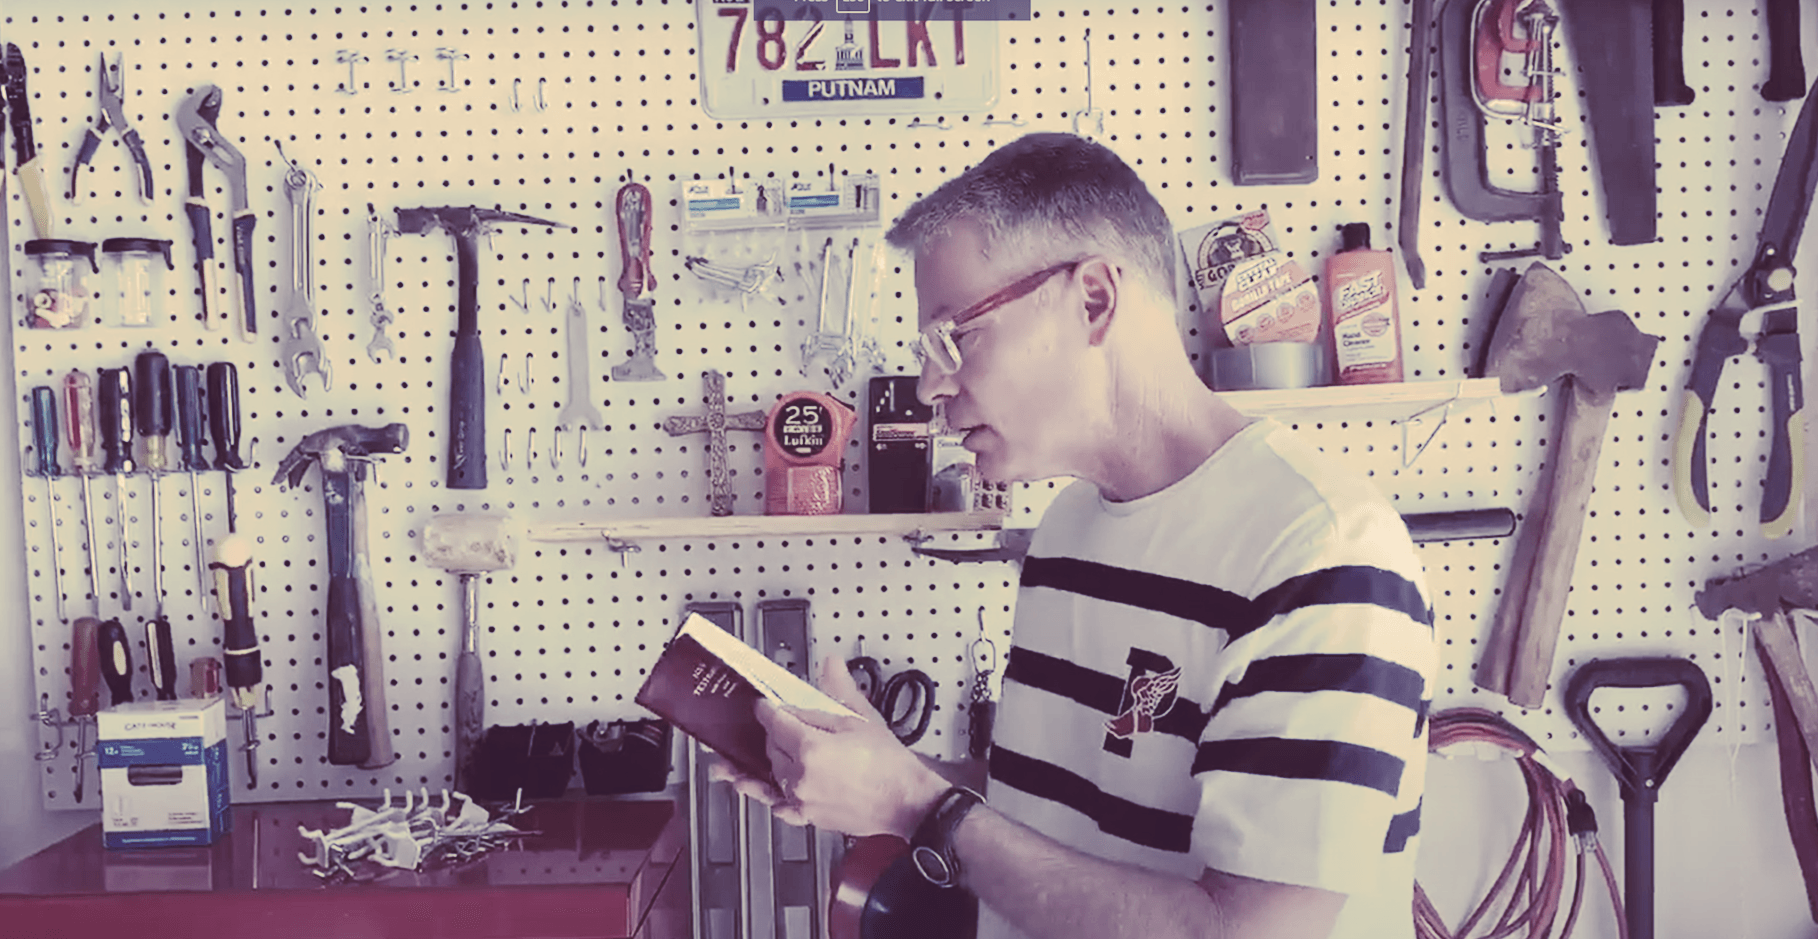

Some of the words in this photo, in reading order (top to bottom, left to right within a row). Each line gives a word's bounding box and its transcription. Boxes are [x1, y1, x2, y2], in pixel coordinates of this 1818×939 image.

[717, 6, 826, 73] 782
[868, 0, 975, 68] LKT
[807, 79, 896, 98] PUTNAM
[784, 434, 823, 446] Lufkin
